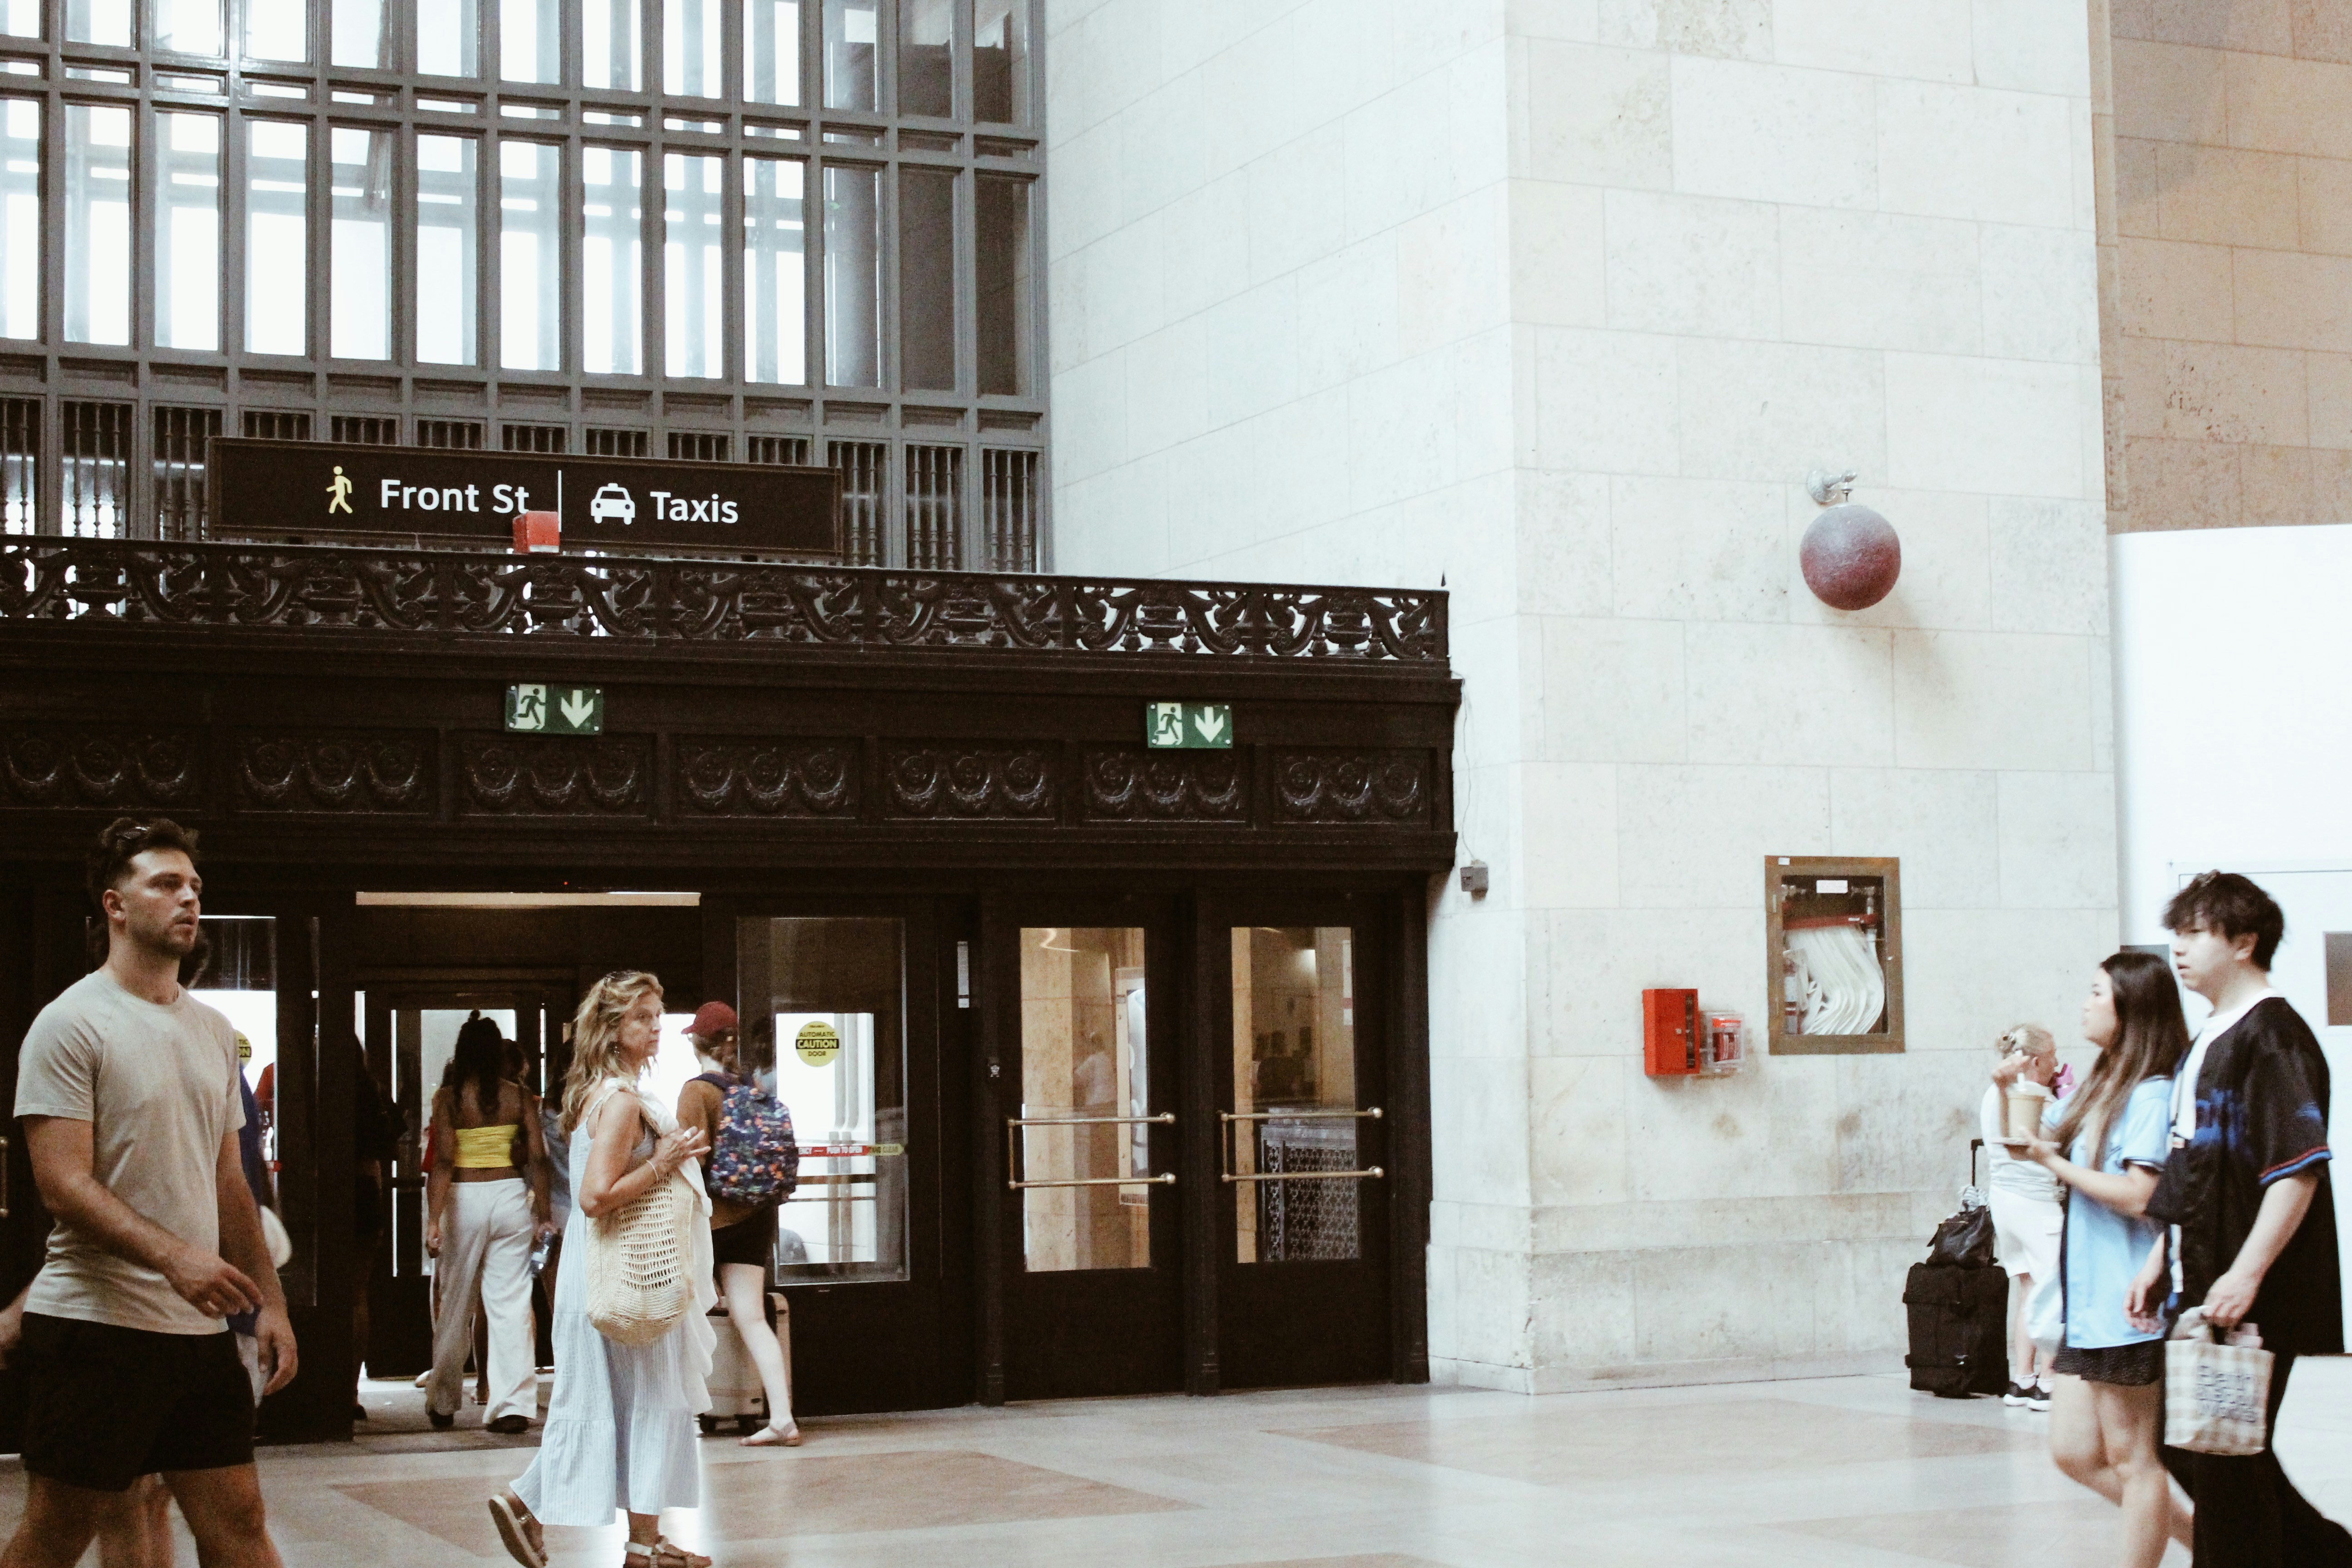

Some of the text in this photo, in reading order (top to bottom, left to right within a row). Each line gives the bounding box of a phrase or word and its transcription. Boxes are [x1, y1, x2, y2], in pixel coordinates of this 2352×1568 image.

[381, 479, 529, 514] Front St
[650, 491, 739, 524] Taxis
[797, 1040, 837, 1048] CAUTION
[827, 1146, 841, 1154] PUSH
[849, 1146, 862, 1154] OPEN
